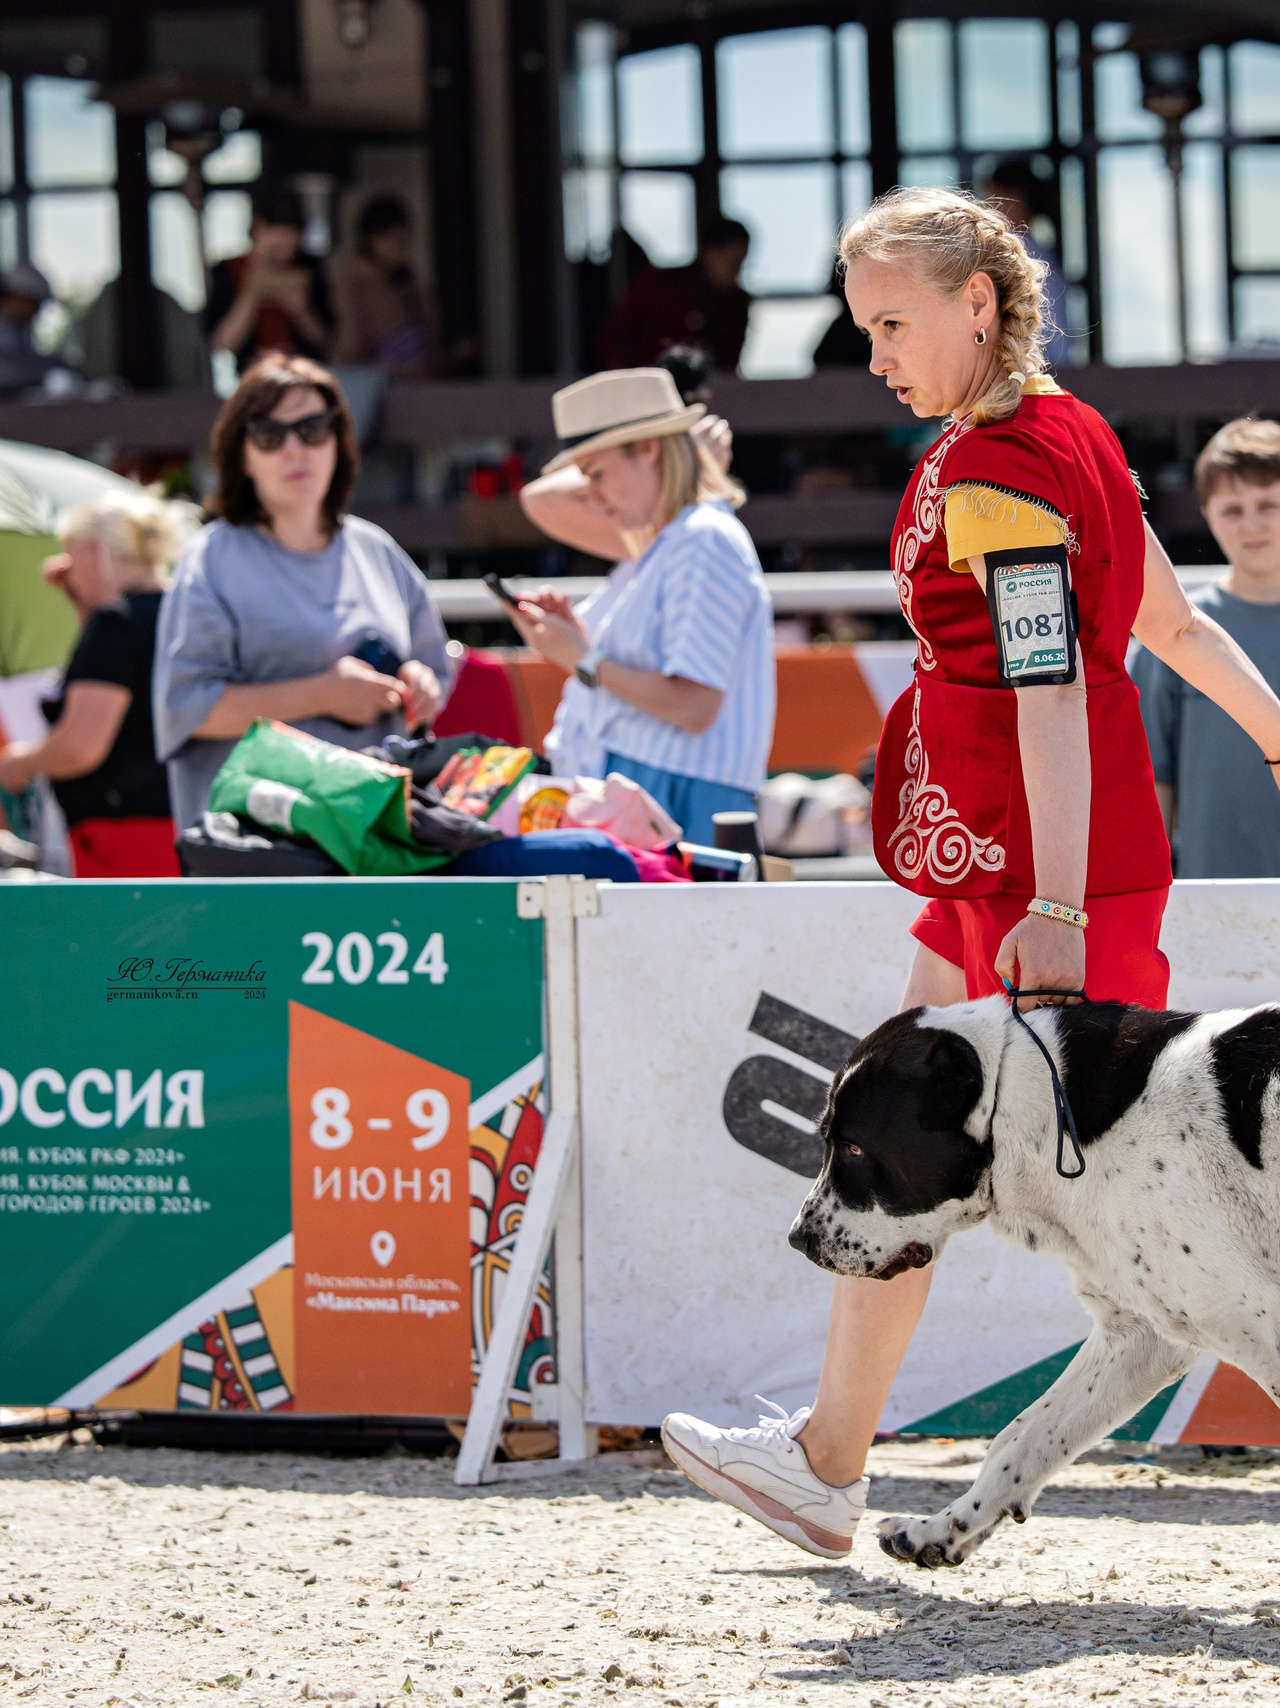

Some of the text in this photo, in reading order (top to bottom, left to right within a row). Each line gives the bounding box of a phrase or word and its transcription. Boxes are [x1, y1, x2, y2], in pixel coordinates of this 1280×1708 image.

[1019, 579, 1052, 588] РОССИЯ
[1001, 613, 1063, 642] 1087
[302, 932, 448, 984] 2024
[310, 1087, 353, 1150] 8
[406, 1088, 451, 1151] 9
[27, 1146, 88, 1165] КУБОК
[91, 1147, 131, 1165] РКФ
[134, 1148, 185, 1166] 2024»
[27, 1174, 89, 1192] КУБОК
[92, 1174, 173, 1193] МОСКВЫ
[177, 1175, 191, 1193] &
[313, 1165, 451, 1203] ИЮНЯ
[160, 1196, 211, 1214] 2024»
